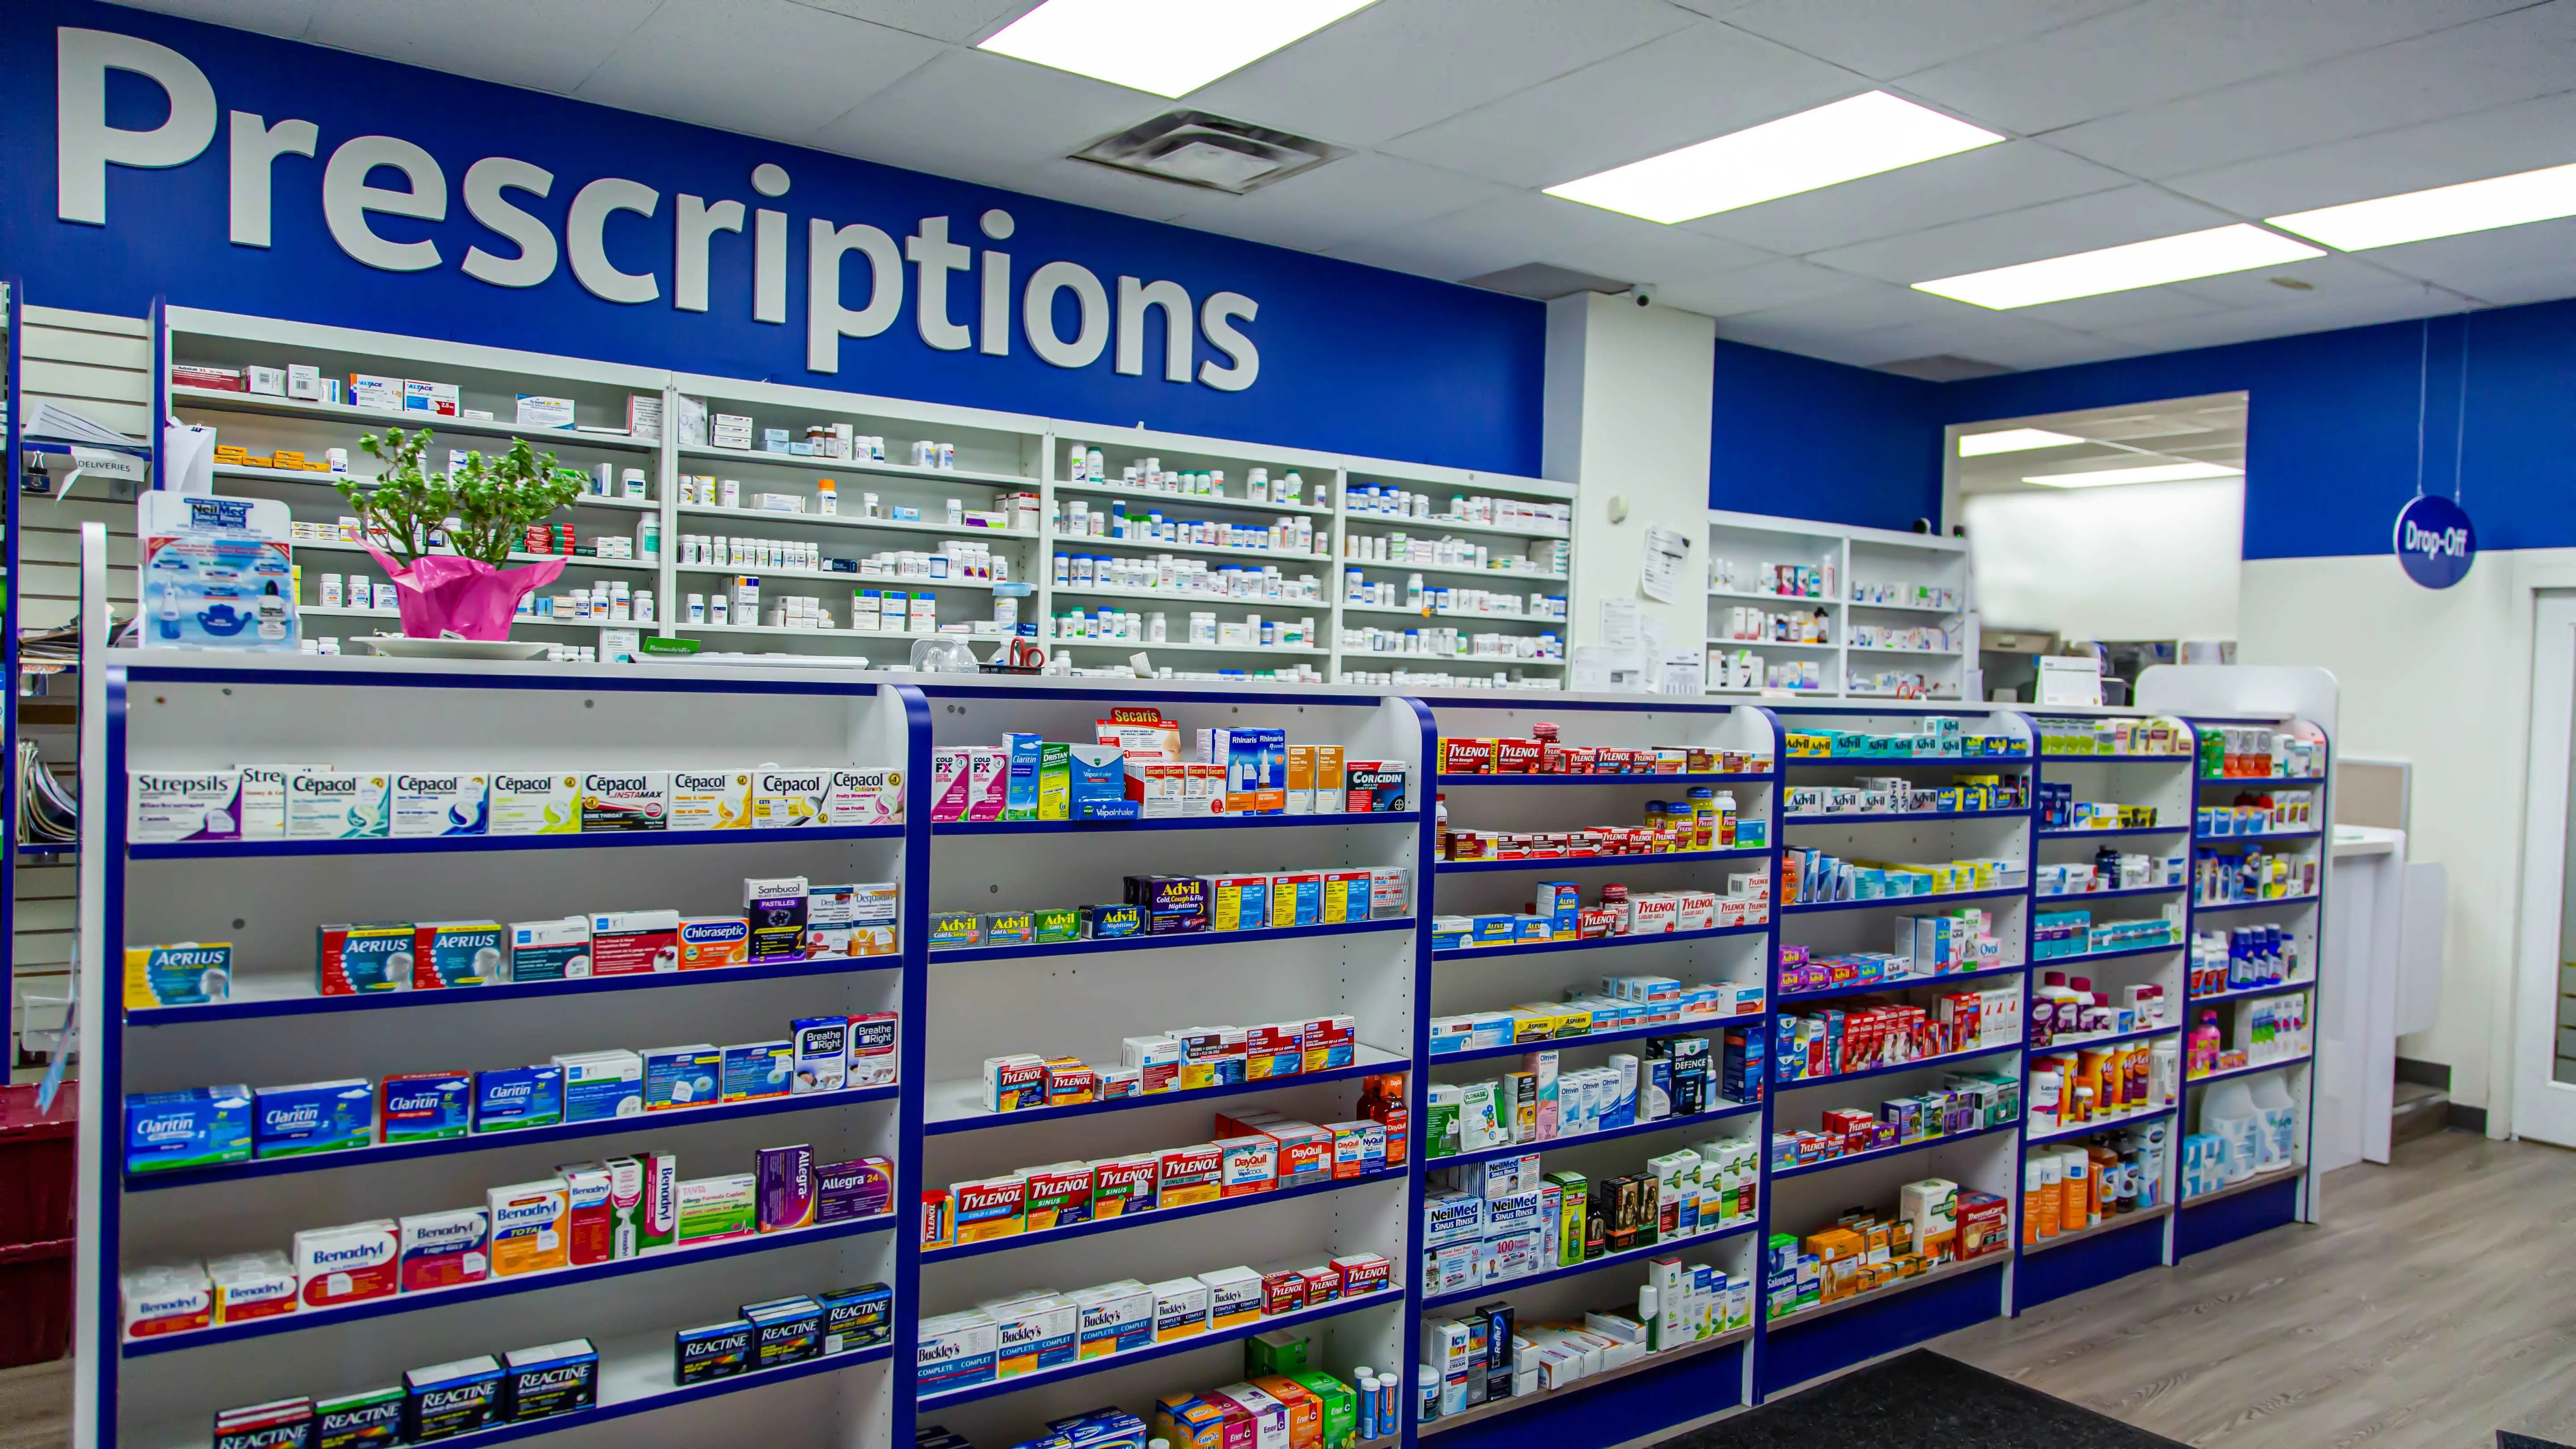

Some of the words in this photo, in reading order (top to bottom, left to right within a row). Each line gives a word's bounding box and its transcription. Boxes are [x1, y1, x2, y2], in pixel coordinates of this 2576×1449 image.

[57, 27, 1259, 393] Prescriptions
[78, 460, 130, 473] DELIVERIES
[2405, 521, 2467, 560] Drop-Off
[1114, 710, 1158, 722] Secaris
[1449, 744, 1490, 758] TYLENOL
[1013, 755, 1036, 763] Claritin
[1043, 754, 1067, 762] DRISTAN
[936, 763, 952, 772] FX
[974, 763, 990, 772] FX
[1353, 771, 1401, 784] CORICIDIN
[139, 775, 228, 795] Strepsils
[1096, 809, 1134, 818] VapoInhaler
[758, 884, 800, 894] Sambucol
[1163, 882, 1200, 895] Advil
[1169, 902, 1198, 911] Nighttime
[1559, 898, 1576, 906] ALEVE
[993, 917, 1029, 929] Advil
[1044, 913, 1075, 924] Advil
[1103, 910, 1137, 923] Advil
[938, 918, 977, 931] Advil
[1487, 923, 1504, 931] ALEVE
[685, 926, 744, 938] Chloraseptic
[806, 1031, 842, 1042] Breathe
[859, 1026, 891, 1037] Breathe
[818, 1039, 842, 1051] Right
[870, 1034, 892, 1045] Right
[1540, 1054, 1557, 1062] Otrivin
[1675, 1059, 1706, 1070] DEFENCE
[1583, 1082, 1599, 1090] Otrivin
[1602, 1079, 1619, 1087] Otrivin
[1465, 1091, 1486, 1100] FLONASE
[1561, 1087, 1579, 1096] Otrivin
[390, 1097, 437, 1111] Claritin
[267, 1109, 318, 1124] Claritin
[137, 1117, 193, 1135] Claritin
[1338, 1140, 1359, 1149] DayQuil
[1363, 1137, 1383, 1146] NyQuil
[1292, 1145, 1322, 1159] DayQuil
[1165, 1158, 1218, 1177] TYLENOL
[1235, 1155, 1267, 1168] DayQuil
[1489, 1161, 1518, 1171] NeilMed
[822, 1174, 864, 1190] Allegra
[867, 1173, 878, 1184] 24
[1100, 1167, 1153, 1187] TYLENOL
[1164, 1178, 1184, 1186] SINUS
[572, 1183, 610, 1197] Benadryl
[660, 1166, 674, 1220] Benadryl
[1033, 1178, 1089, 1198] TYLENOL
[1106, 1187, 1127, 1195] SINUS
[1566, 1184, 1587, 1193] NeilMed
[962, 1191, 1021, 1211] TYLENOL
[1682, 1191, 1698, 1199] INJURY
[1038, 1198, 1060, 1207] SINUS
[1492, 1195, 1537, 1212] NeilMed
[497, 1201, 557, 1221] Benadryl
[1431, 1203, 1478, 1221] NeilMed
[1495, 1212, 1514, 1221] SINUS
[1516, 1208, 1534, 1217] RINSE
[1968, 1207, 2005, 1220] ThermaCare
[418, 1221, 475, 1238] Benadryl
[1435, 1221, 1454, 1231] SINUS
[1456, 1216, 1474, 1226] RINSE
[314, 1241, 384, 1264] Benadryl
[1497, 1241, 1513, 1253] 100
[1767, 1274, 1794, 1288] Salonpas
[1799, 1282, 1818, 1292] Salonpas
[1215, 1290, 1241, 1303] Buckley's
[830, 1300, 887, 1321] REACTINE
[1160, 1302, 1186, 1316] Buckley's
[1084, 1310, 1120, 1327] Buckley's
[762, 1322, 816, 1341] REACTINE
[1002, 1326, 1041, 1343] Buckley's
[1084, 1328, 1114, 1339] COMPLETE
[1121, 1321, 1147, 1331] COMPLET
[685, 1336, 746, 1356] REACTINE
[1002, 1344, 1035, 1356] COMPLETE
[1042, 1336, 1070, 1347] COMPLET
[1452, 1335, 1465, 1347] ICY
[918, 1343, 959, 1362] Buckley's
[1449, 1345, 1466, 1357] HOT
[918, 1364, 953, 1377] COMPLETE
[961, 1357, 991, 1368] COMPLET
[518, 1364, 589, 1388] REACTINE
[422, 1382, 496, 1408] REACTINE
[324, 1404, 400, 1431] REACTINE
[1198, 1433, 1219, 1444] Ester-C
